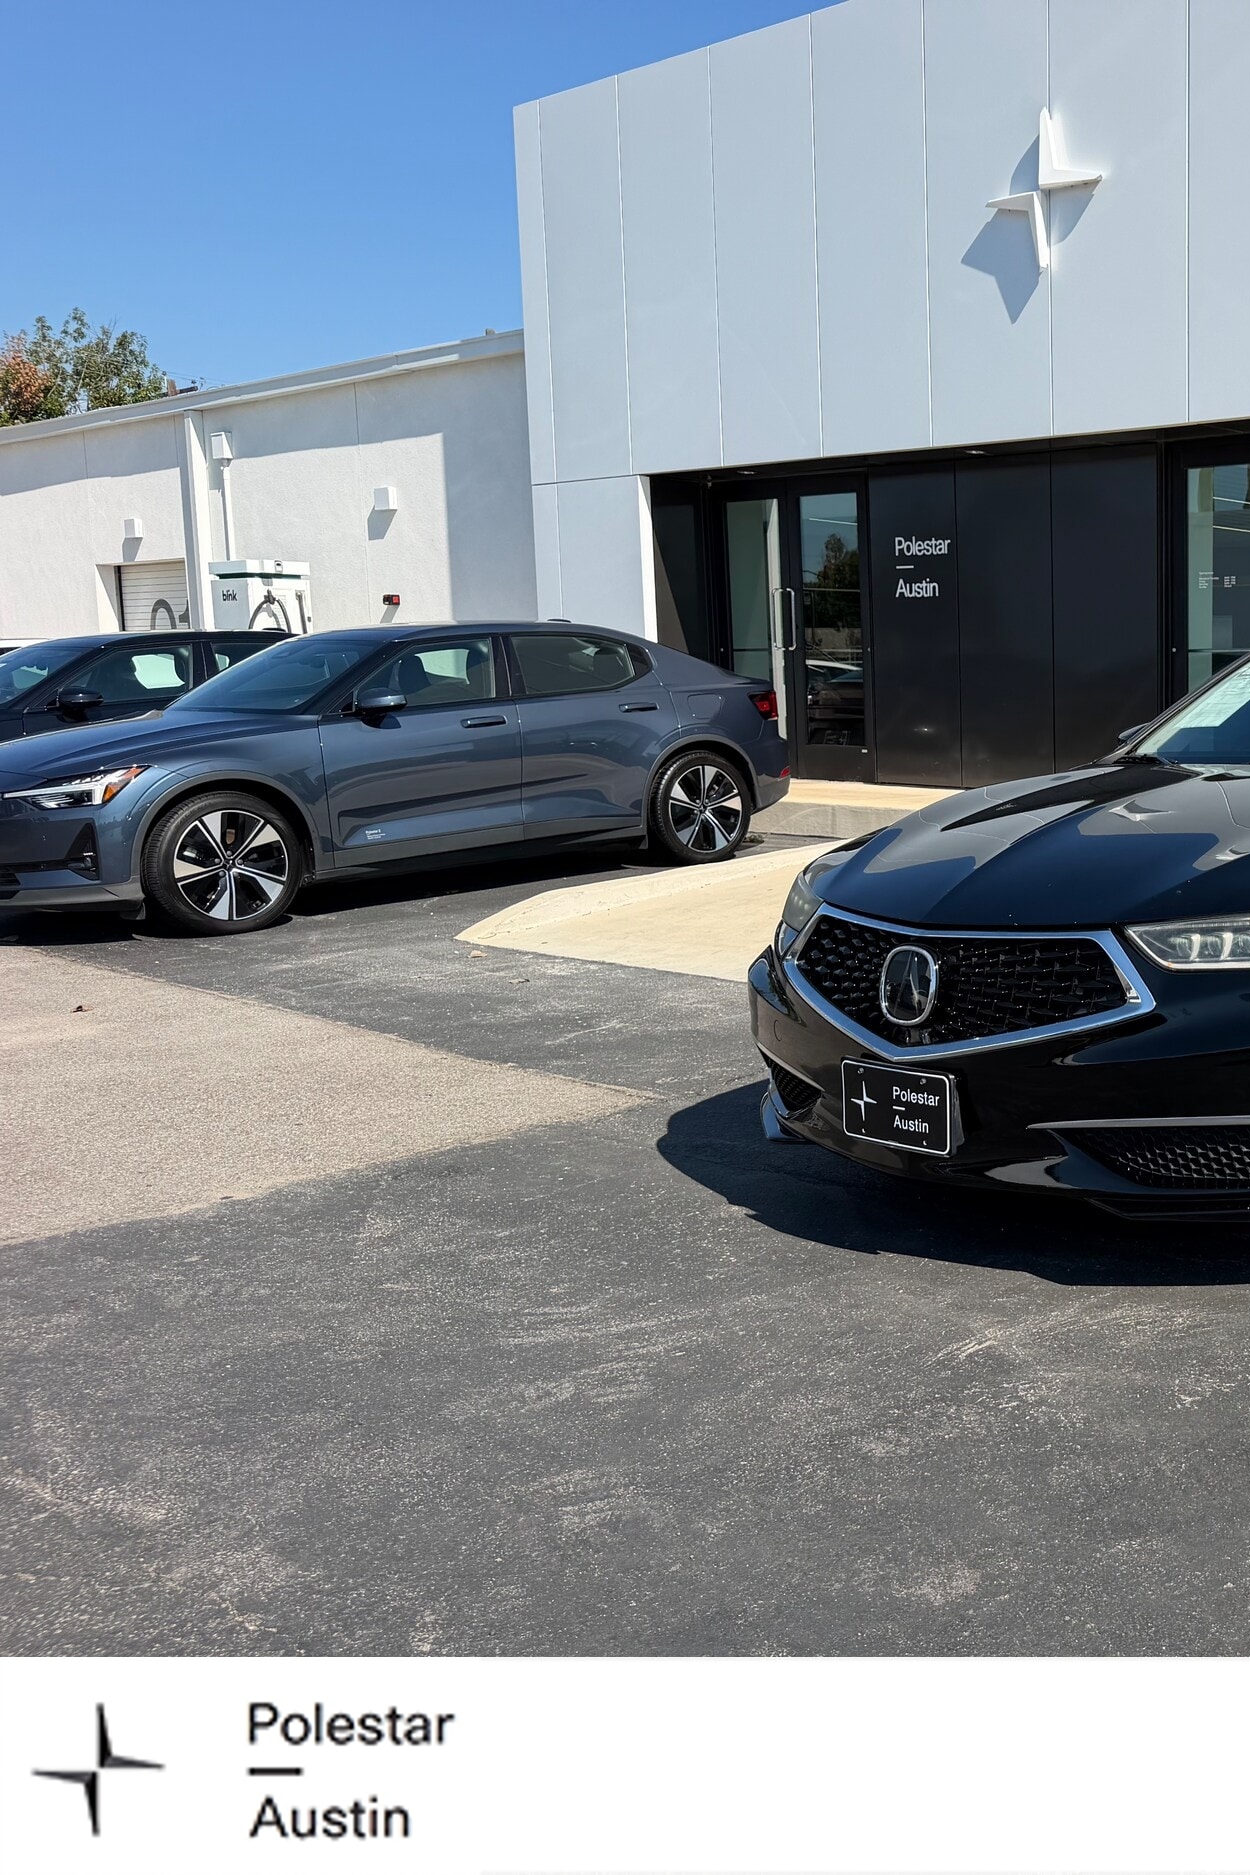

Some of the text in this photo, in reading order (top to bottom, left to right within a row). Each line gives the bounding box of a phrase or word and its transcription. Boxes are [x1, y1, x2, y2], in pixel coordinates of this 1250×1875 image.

[895, 535, 951, 556] Polestar
[221, 589, 238, 602] blink
[895, 578, 939, 598] Austin
[892, 1086, 940, 1107] Polestar
[893, 1114, 929, 1134] Austin
